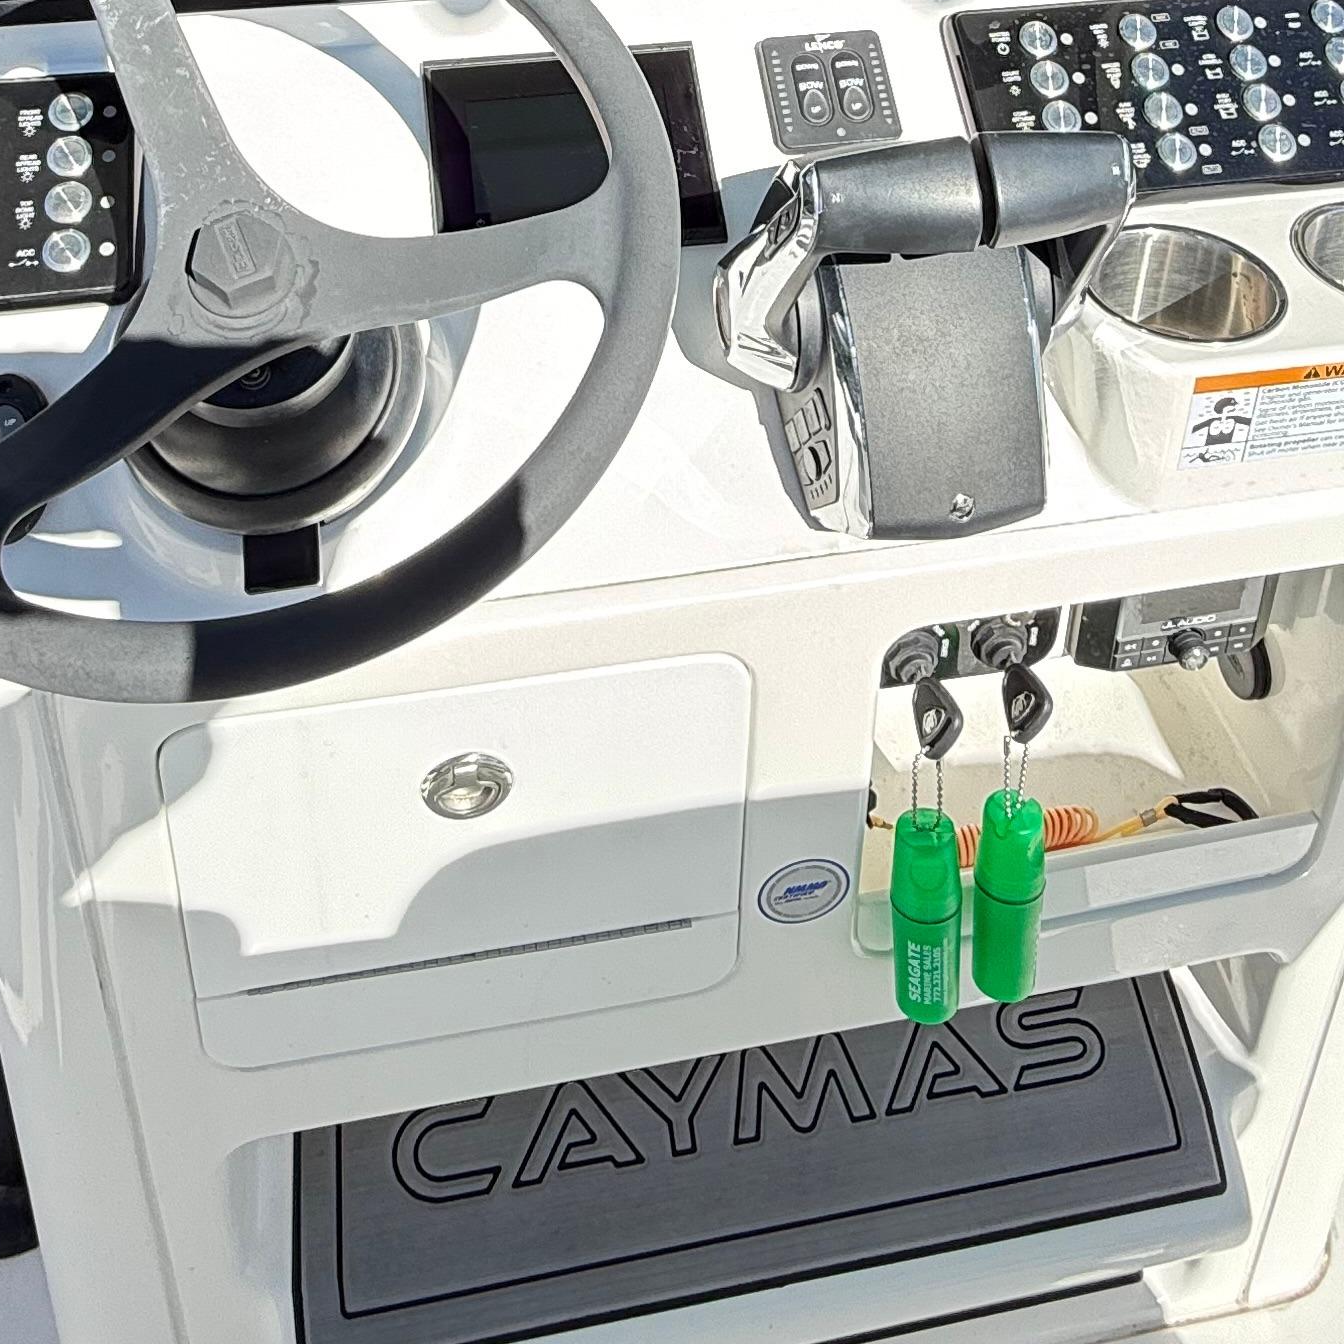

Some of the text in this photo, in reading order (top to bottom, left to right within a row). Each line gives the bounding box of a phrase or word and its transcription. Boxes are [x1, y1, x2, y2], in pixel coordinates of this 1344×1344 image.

[799, 77, 865, 92] BOW BOW
[16, 248, 36, 257] ACC
[4, 418, 17, 426] UP
[1177, 614, 1217, 627] AUDIO
[907, 938, 922, 1003] SEAGATE
[393, 988, 1106, 1204] CAYMAS
